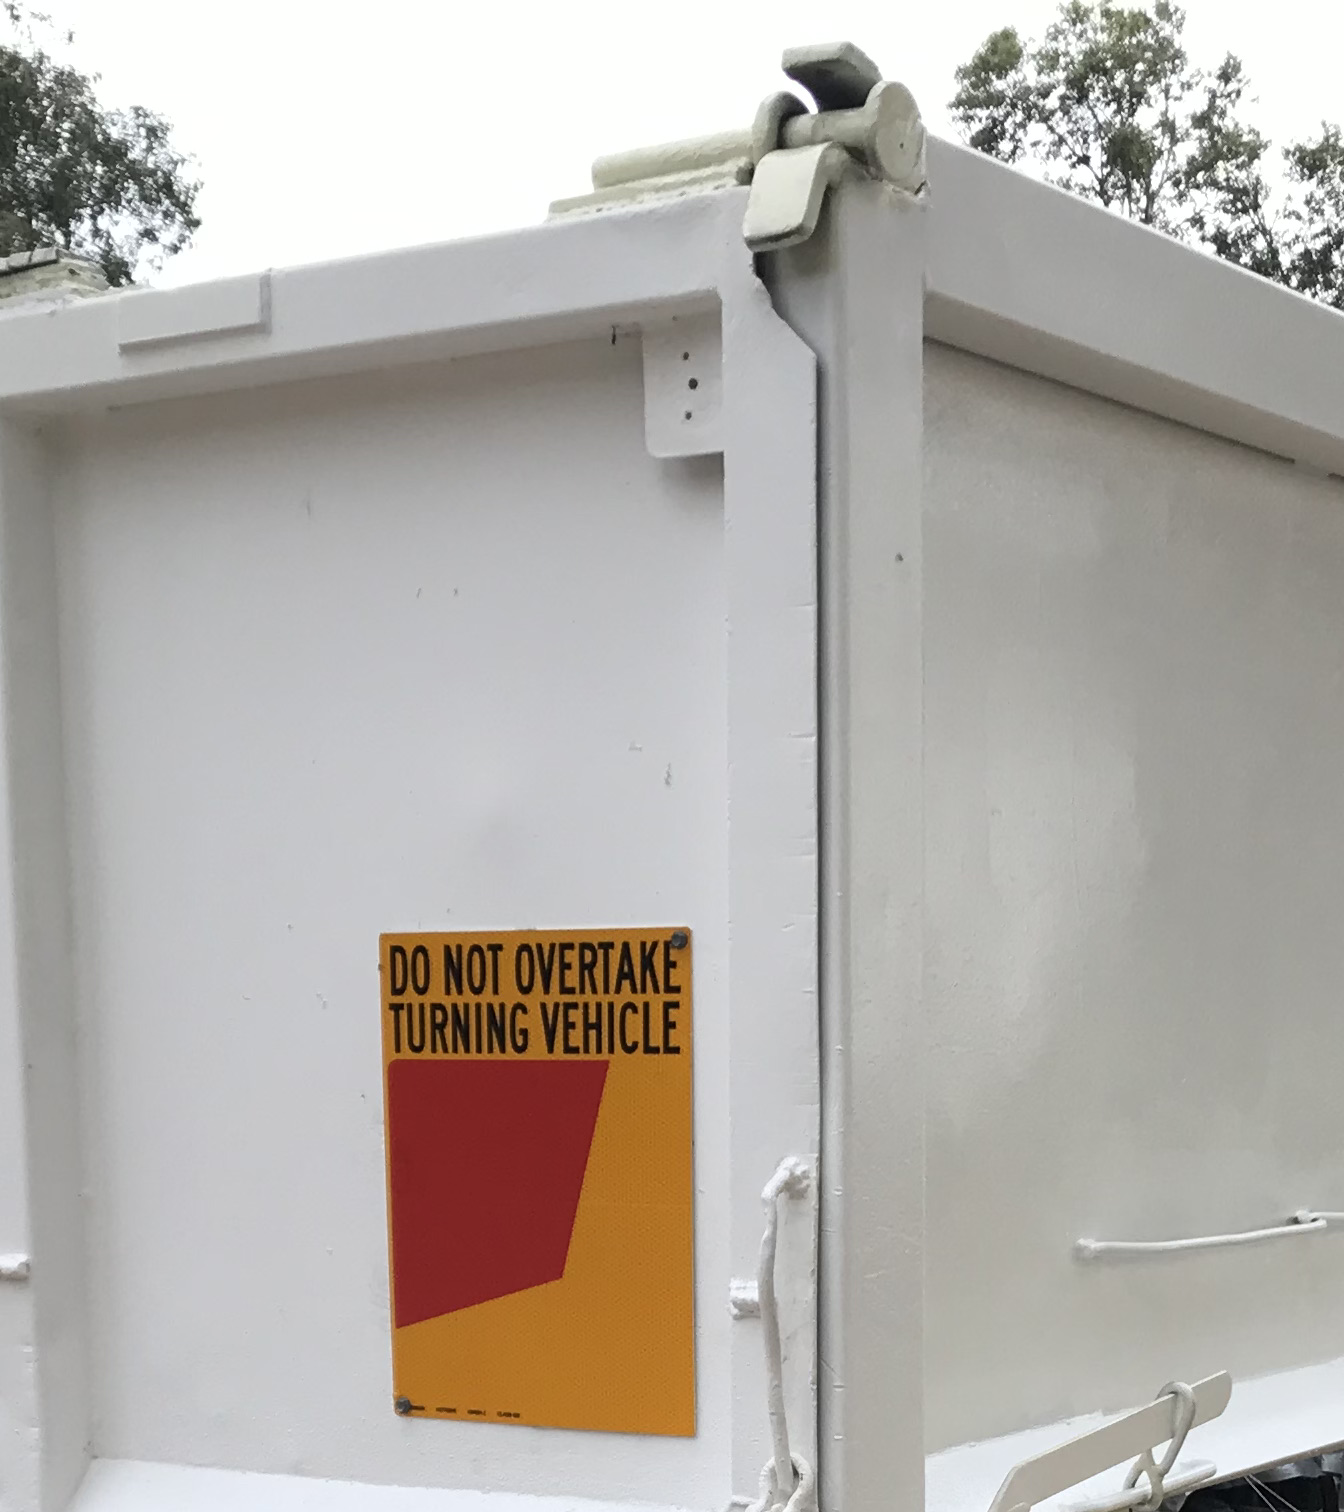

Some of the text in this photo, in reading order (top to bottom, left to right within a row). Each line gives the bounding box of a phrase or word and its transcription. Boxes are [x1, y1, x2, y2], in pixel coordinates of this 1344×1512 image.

[389, 940, 681, 996] DO NOT OVERTAKE
[389, 1001, 681, 1055] TURNING VEHICLE
